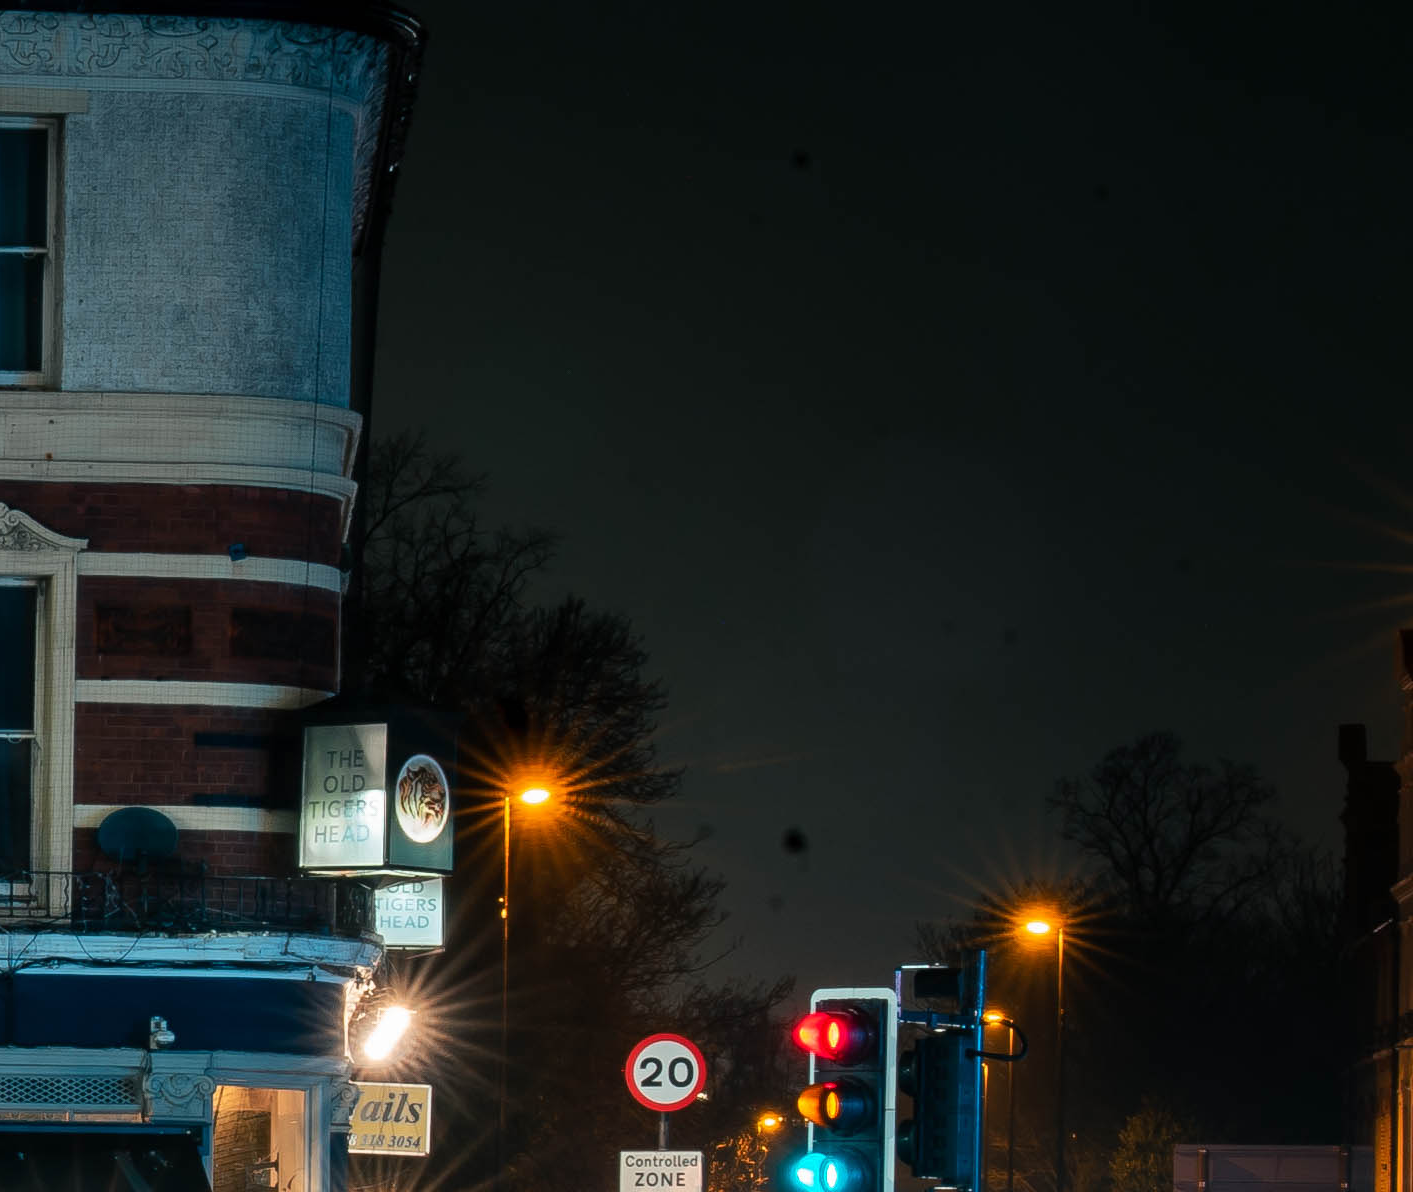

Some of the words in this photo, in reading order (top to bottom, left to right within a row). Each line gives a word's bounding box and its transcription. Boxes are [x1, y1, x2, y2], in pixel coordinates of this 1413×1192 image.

[327, 750, 365, 768] THE
[324, 775, 366, 793] OLD
[309, 800, 377, 819] TIGERS
[314, 825, 370, 843] HEAD
[375, 898, 437, 911] TIGERS
[380, 915, 430, 928] HEAD
[640, 1057, 694, 1088] 20
[350, 1091, 423, 1123] ails
[388, 1135, 422, 1148] 3054
[625, 1155, 698, 1167] Controlled
[635, 1172, 686, 1187] ZONE
